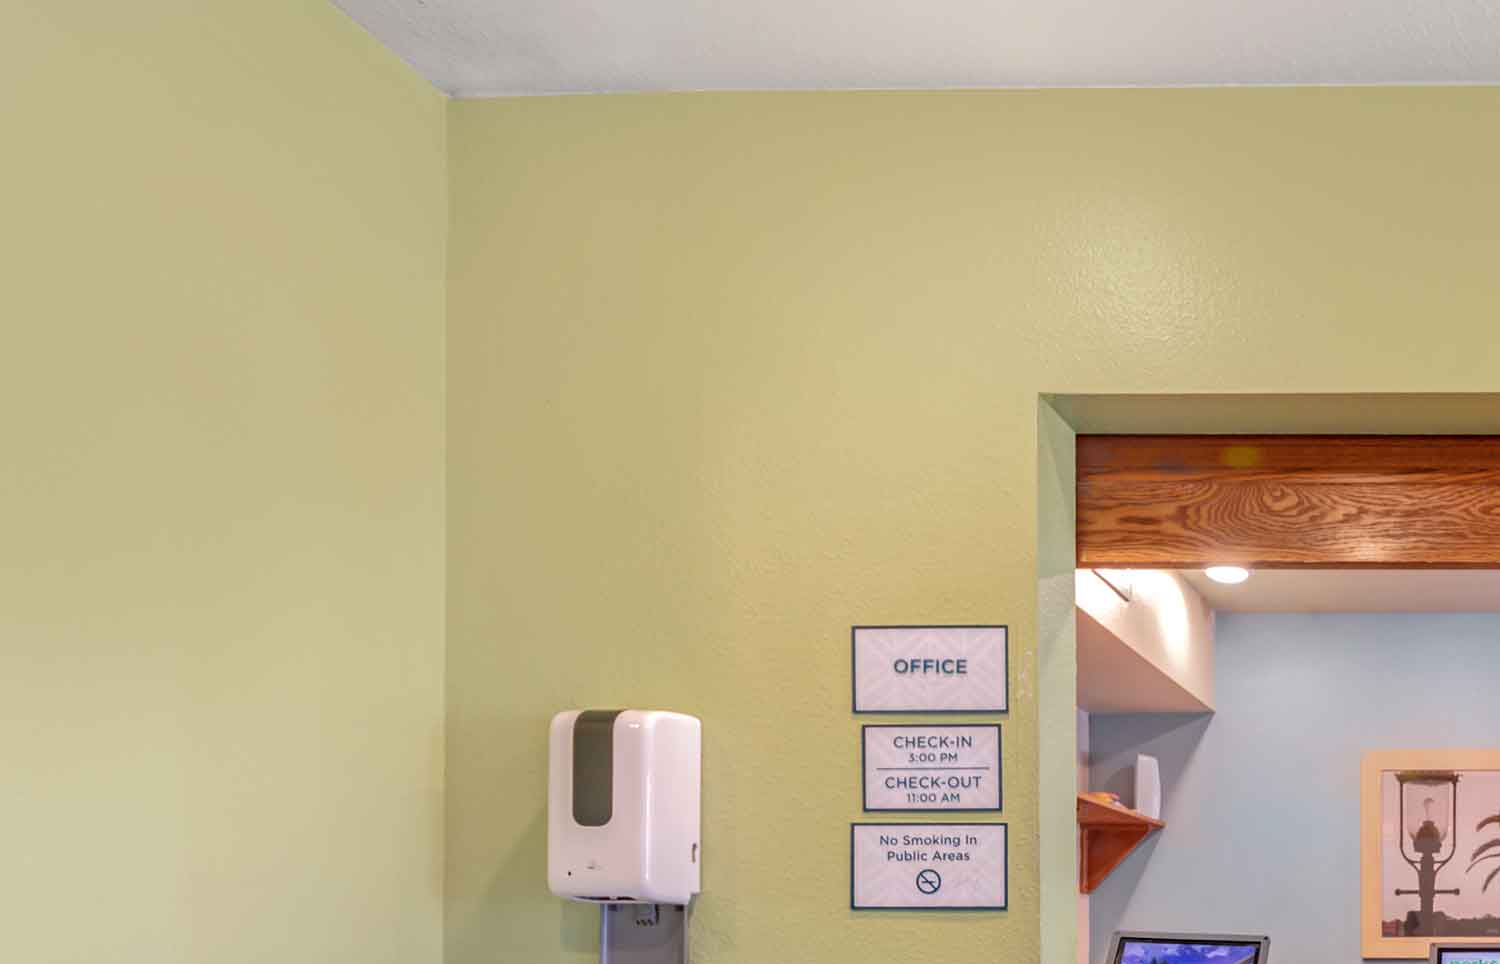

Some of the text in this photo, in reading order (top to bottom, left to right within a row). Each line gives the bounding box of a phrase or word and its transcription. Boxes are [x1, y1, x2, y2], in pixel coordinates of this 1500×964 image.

[893, 658, 968, 675] OFFICE
[893, 736, 973, 749] CHECK-IN
[908, 752, 958, 763] 3:00 PM
[885, 776, 982, 789] CHECK-OUT
[907, 793, 961, 803] 11:00 AM
[879, 834, 978, 848] No Smoking In
[887, 850, 970, 862] Public Areas
